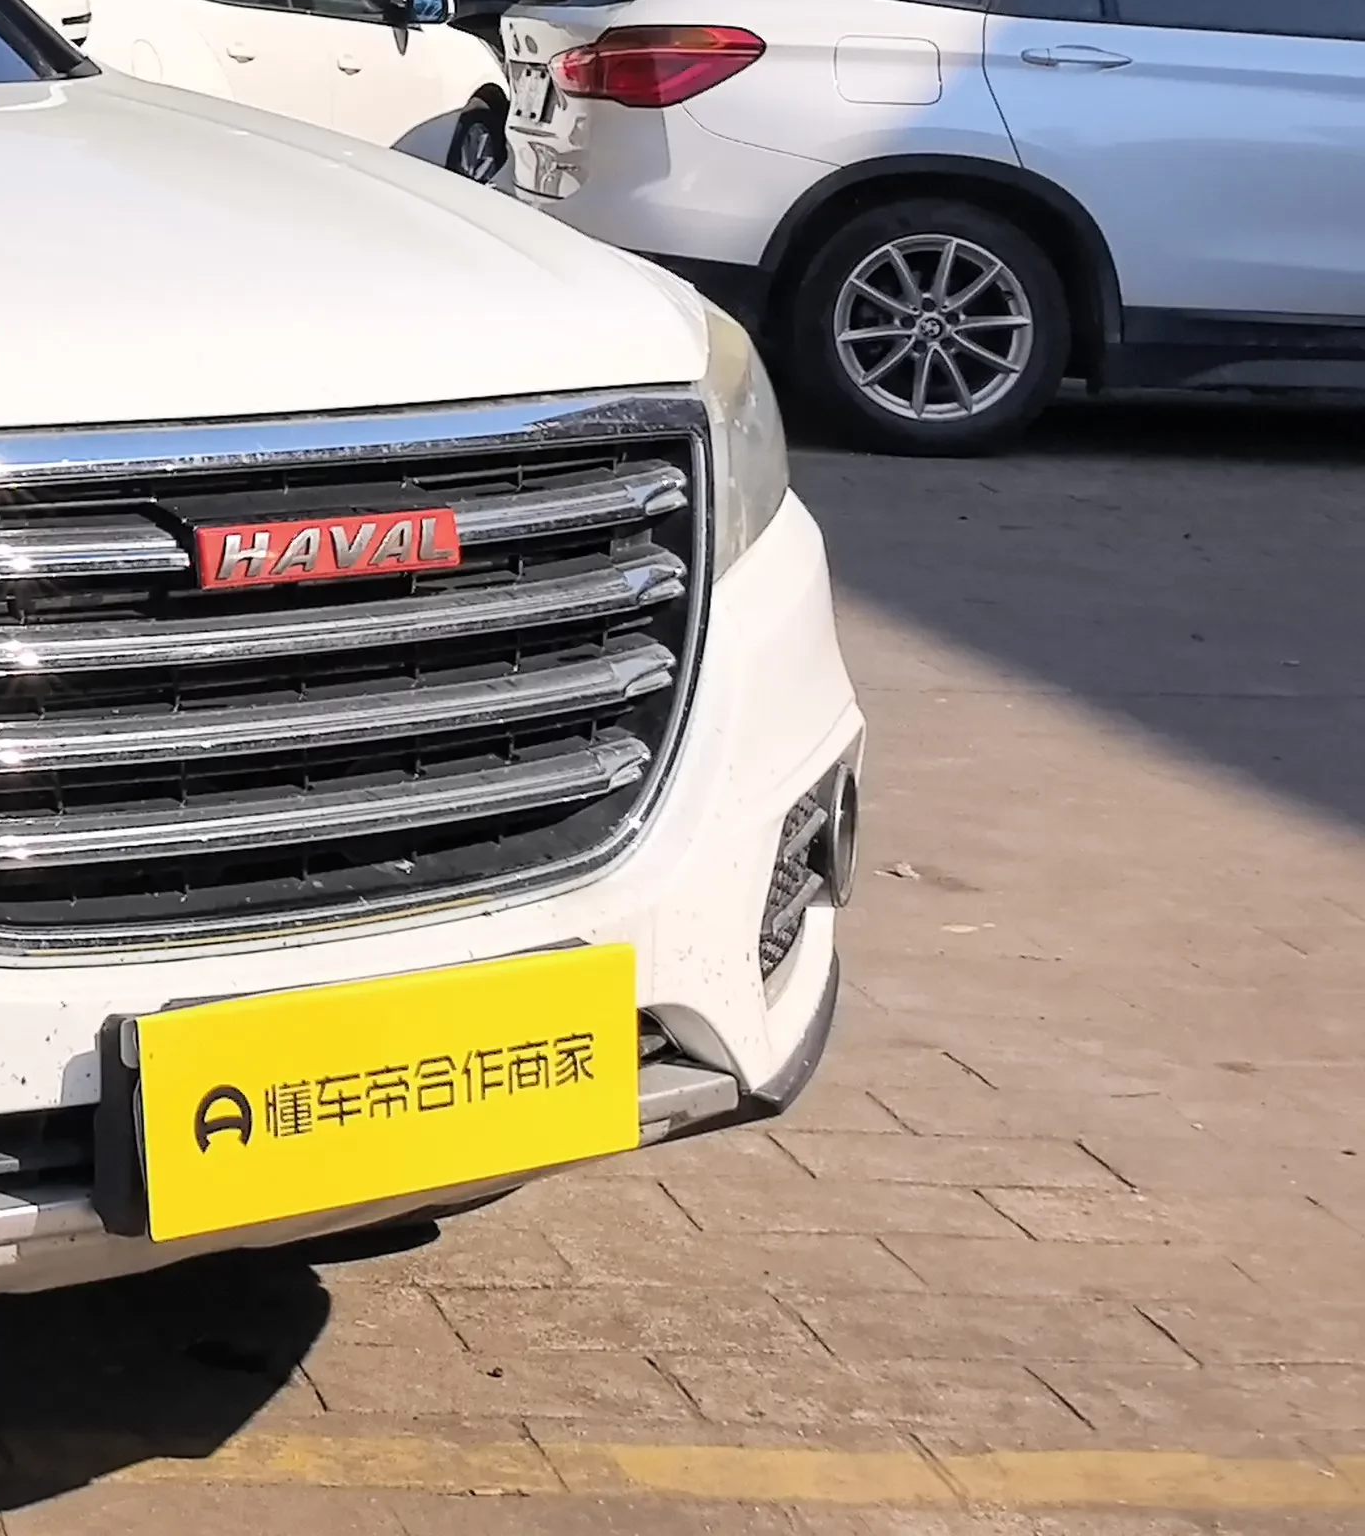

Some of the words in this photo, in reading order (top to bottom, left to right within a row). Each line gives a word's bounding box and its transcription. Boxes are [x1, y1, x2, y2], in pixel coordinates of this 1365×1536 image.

[217, 517, 455, 580] HAVAL
[263, 1032, 595, 1139] 懂车帝合作商家
